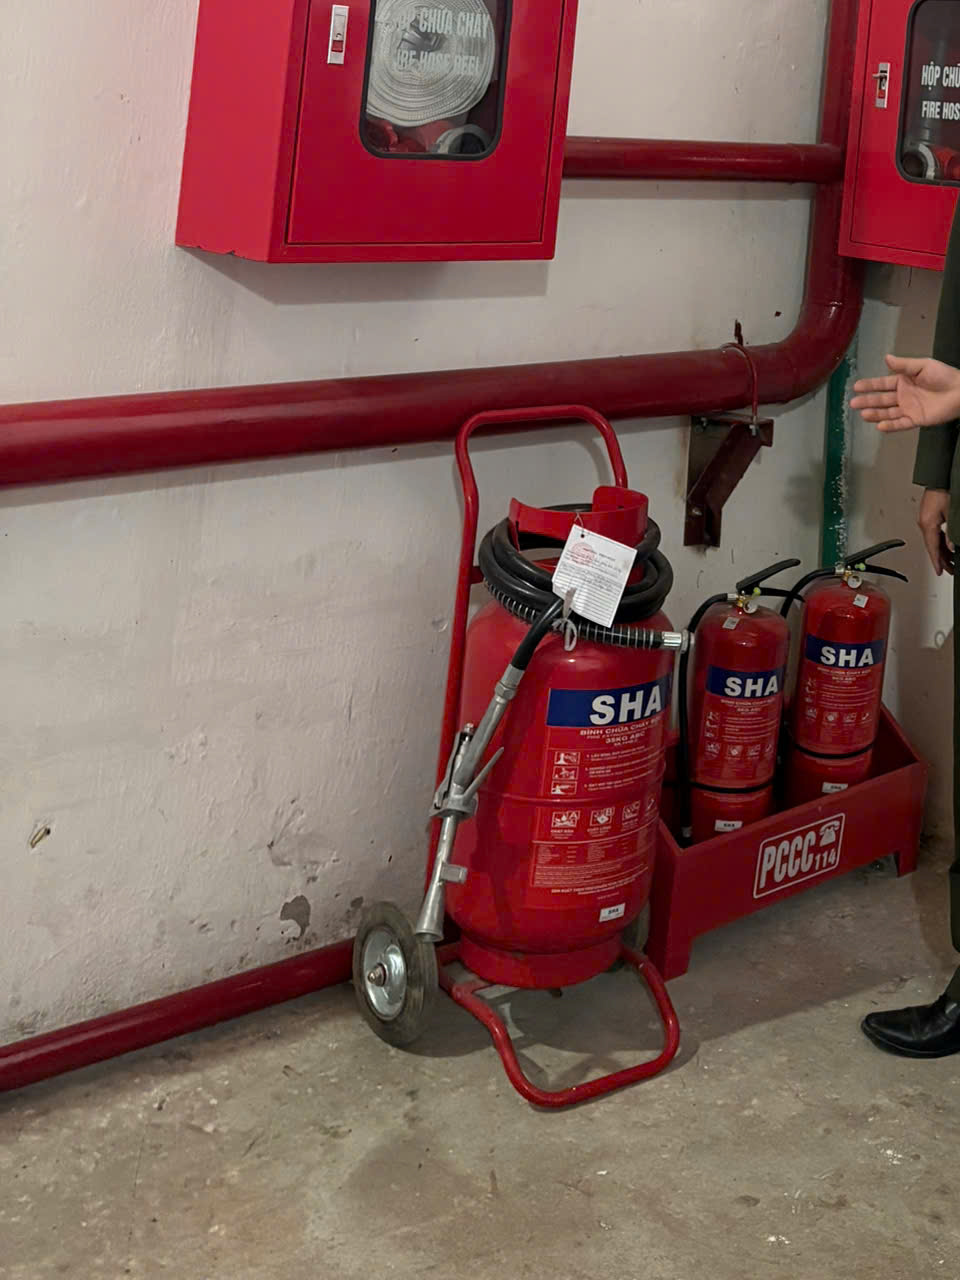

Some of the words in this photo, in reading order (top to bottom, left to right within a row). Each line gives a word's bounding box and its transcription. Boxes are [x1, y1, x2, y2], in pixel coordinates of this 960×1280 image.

[456, 8, 490, 39] CHÁY
[921, 61, 941, 91] HỘP
[922, 100, 942, 118] FIRE
[820, 646, 874, 668] SHA
[724, 675, 778, 698] SHA
[589, 685, 662, 726] SHA
[759, 831, 817, 889] PCCC
[815, 848, 836, 870] 114
